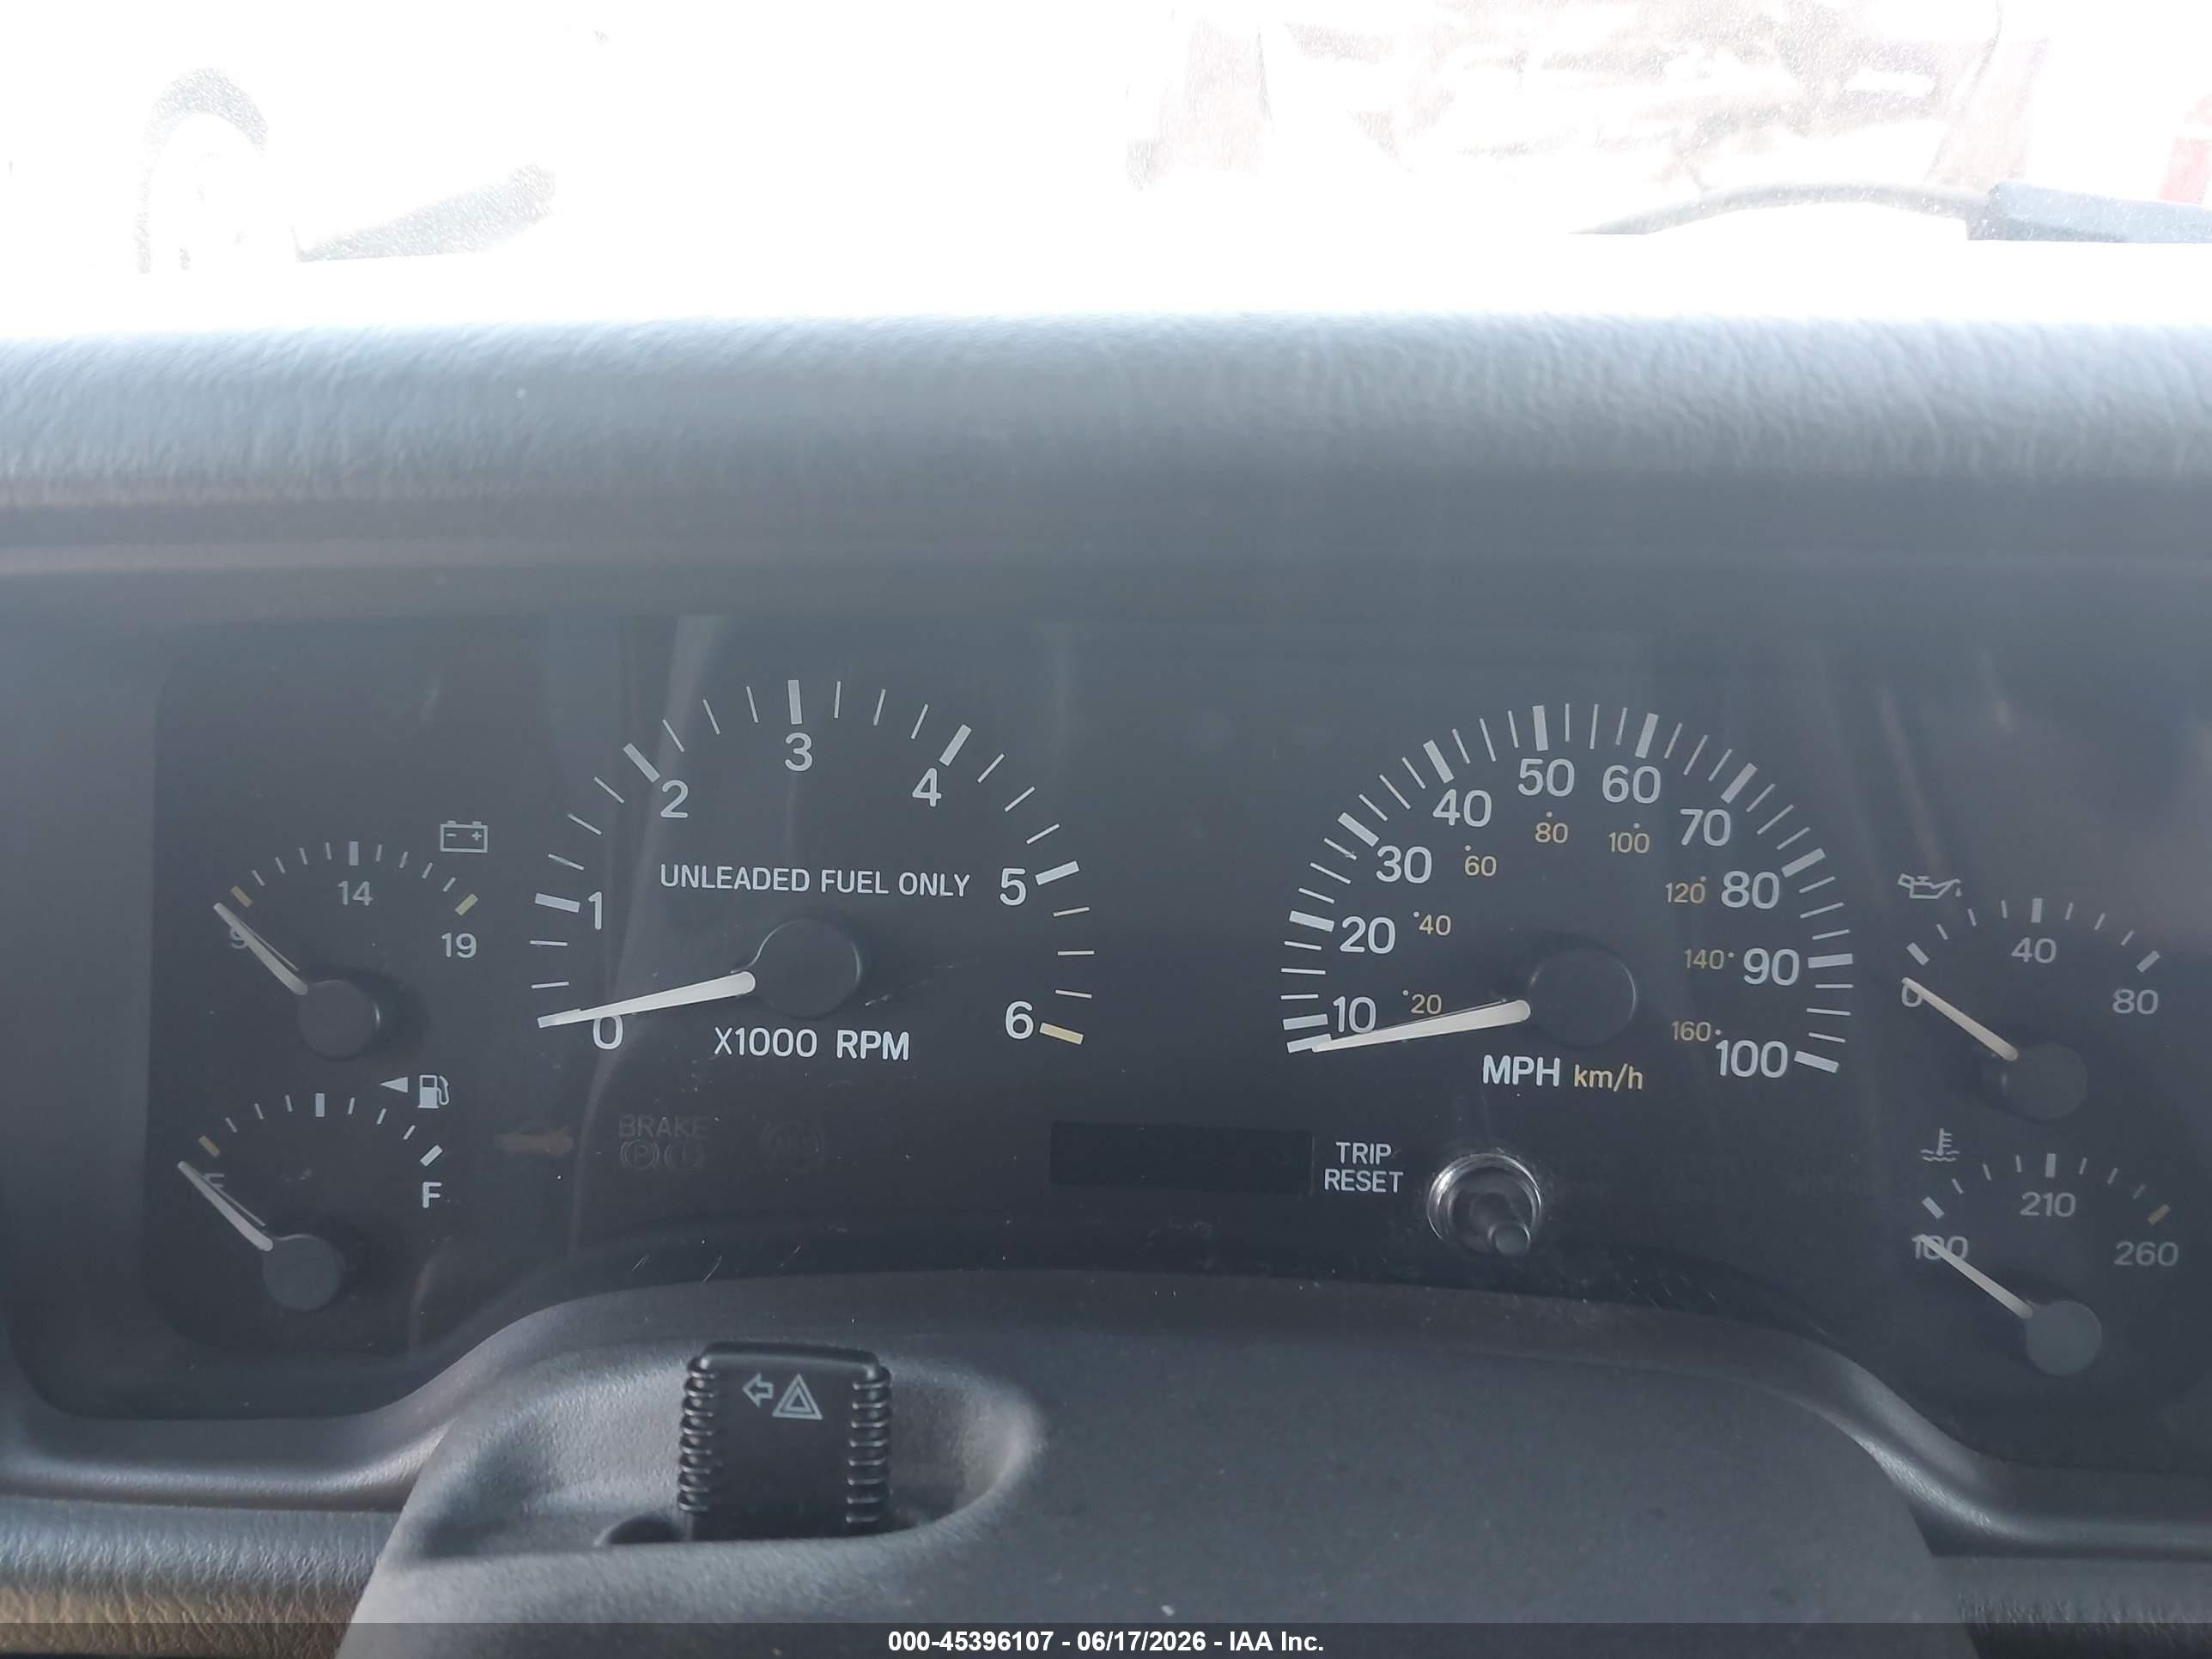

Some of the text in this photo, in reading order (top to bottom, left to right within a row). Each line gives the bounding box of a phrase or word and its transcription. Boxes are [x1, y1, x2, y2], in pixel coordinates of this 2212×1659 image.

[785, 732, 812, 771] 3
[913, 769, 941, 806] 4
[1518, 759, 1574, 796] 50
[1603, 765, 1660, 803] 60
[660, 781, 688, 817] 2
[1433, 789, 1492, 827] 40
[1535, 823, 1568, 842] 80
[1609, 832, 1650, 853] 100
[1680, 809, 1730, 846] 70
[661, 864, 969, 896] UNLEADED FUEL ONLY
[1376, 846, 1431, 883] 30
[1465, 856, 1496, 876] 60
[338, 881, 373, 906] 14
[1000, 868, 1026, 905] 5
[1666, 884, 1705, 903] 120
[1722, 871, 1779, 908] 80
[588, 892, 602, 930] 1
[1419, 915, 1450, 935] 40
[442, 933, 476, 957] 19
[1340, 916, 1395, 953] 20
[2011, 938, 2057, 963] 40
[1685, 949, 1724, 969] 140
[1744, 948, 1799, 985] 90
[1411, 994, 1442, 1014] 20
[1901, 981, 1923, 1007] 0
[2113, 989, 2158, 1014] 80
[1006, 1001, 1033, 1039] 6
[1333, 996, 1376, 1033] 10
[592, 1014, 623, 1050] 0
[714, 1027, 908, 1060] X1000 RPM
[1673, 1022, 1711, 1042] 160
[1483, 1055, 1642, 1091] MPH km/h
[1716, 1040, 1788, 1078] 100
[618, 1115, 708, 1138] BRAKE
[1336, 1142, 1391, 1164] TRIP
[422, 1182, 441, 1208] F
[1325, 1169, 1403, 1193] RESET
[2020, 1192, 2075, 1217] 210
[2114, 1242, 2179, 1266] 260
